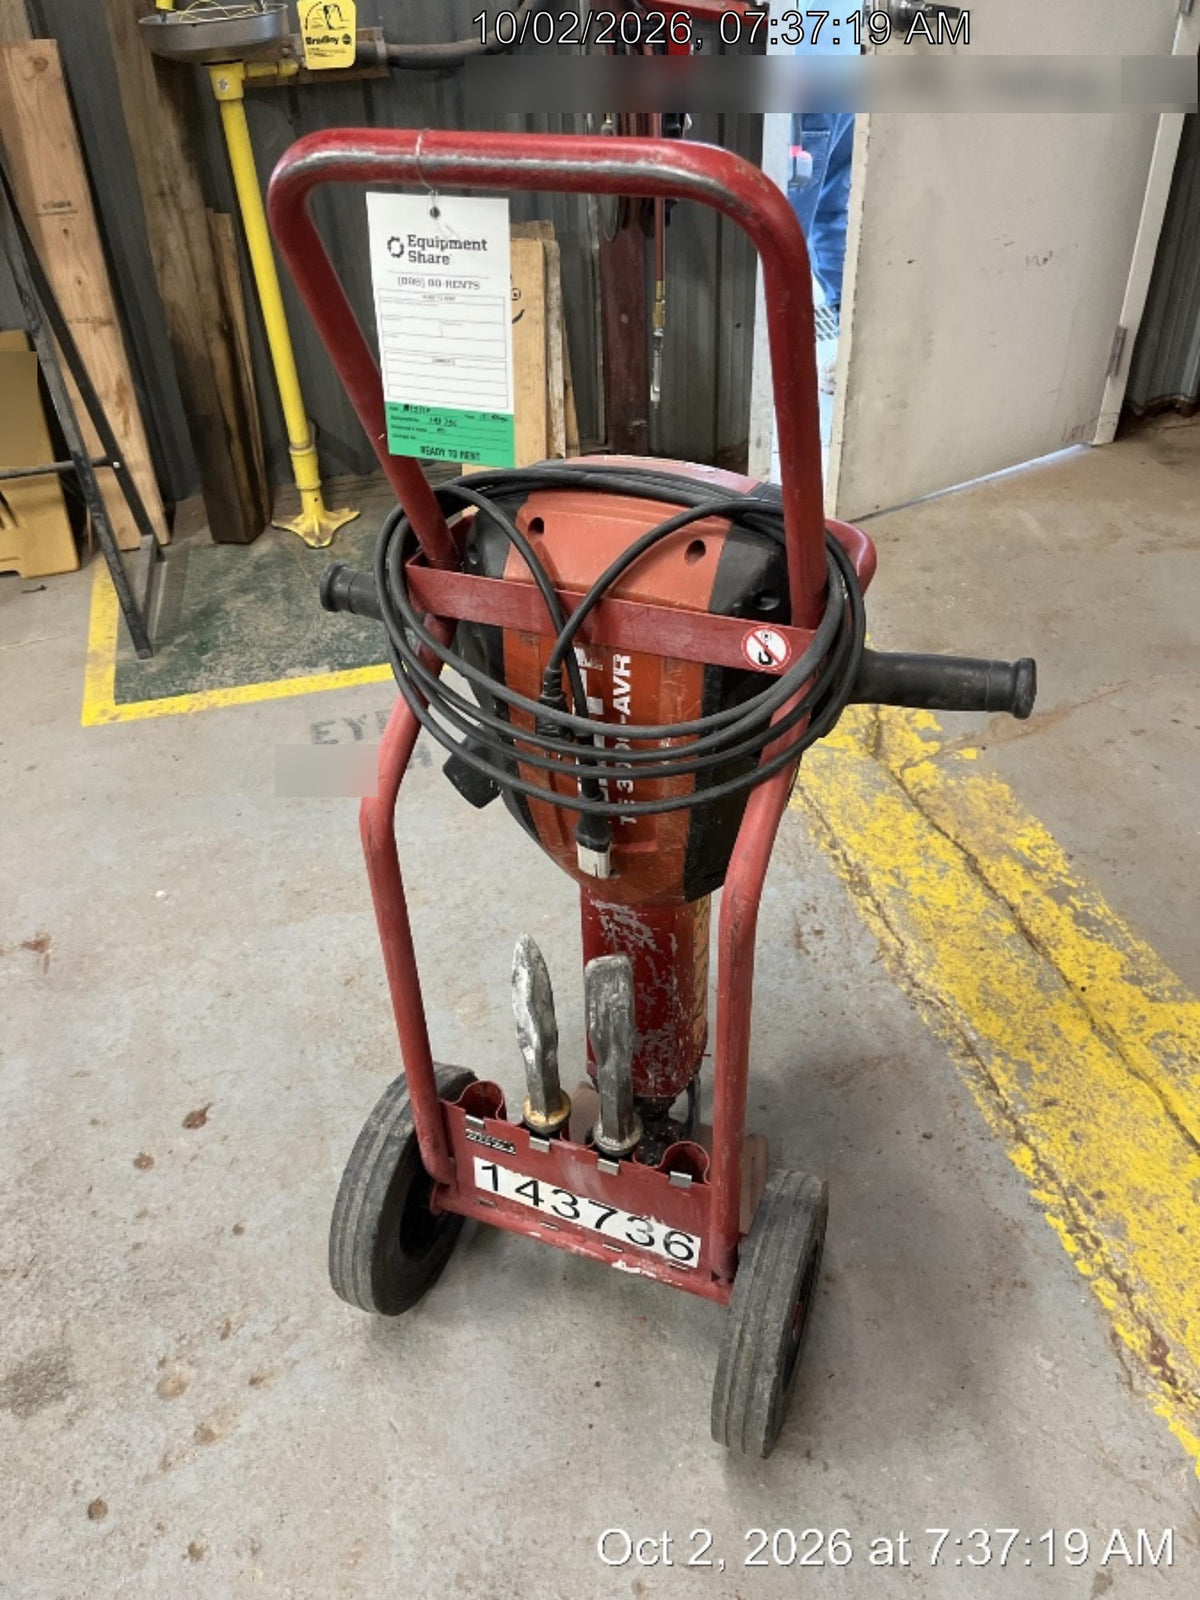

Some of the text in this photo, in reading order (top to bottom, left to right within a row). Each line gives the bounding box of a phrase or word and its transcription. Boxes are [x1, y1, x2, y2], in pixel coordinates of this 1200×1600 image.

[406, 233, 488, 252] Equipment
[408, 250, 451, 266] Share
[481, 1164, 694, 1261] 143736
